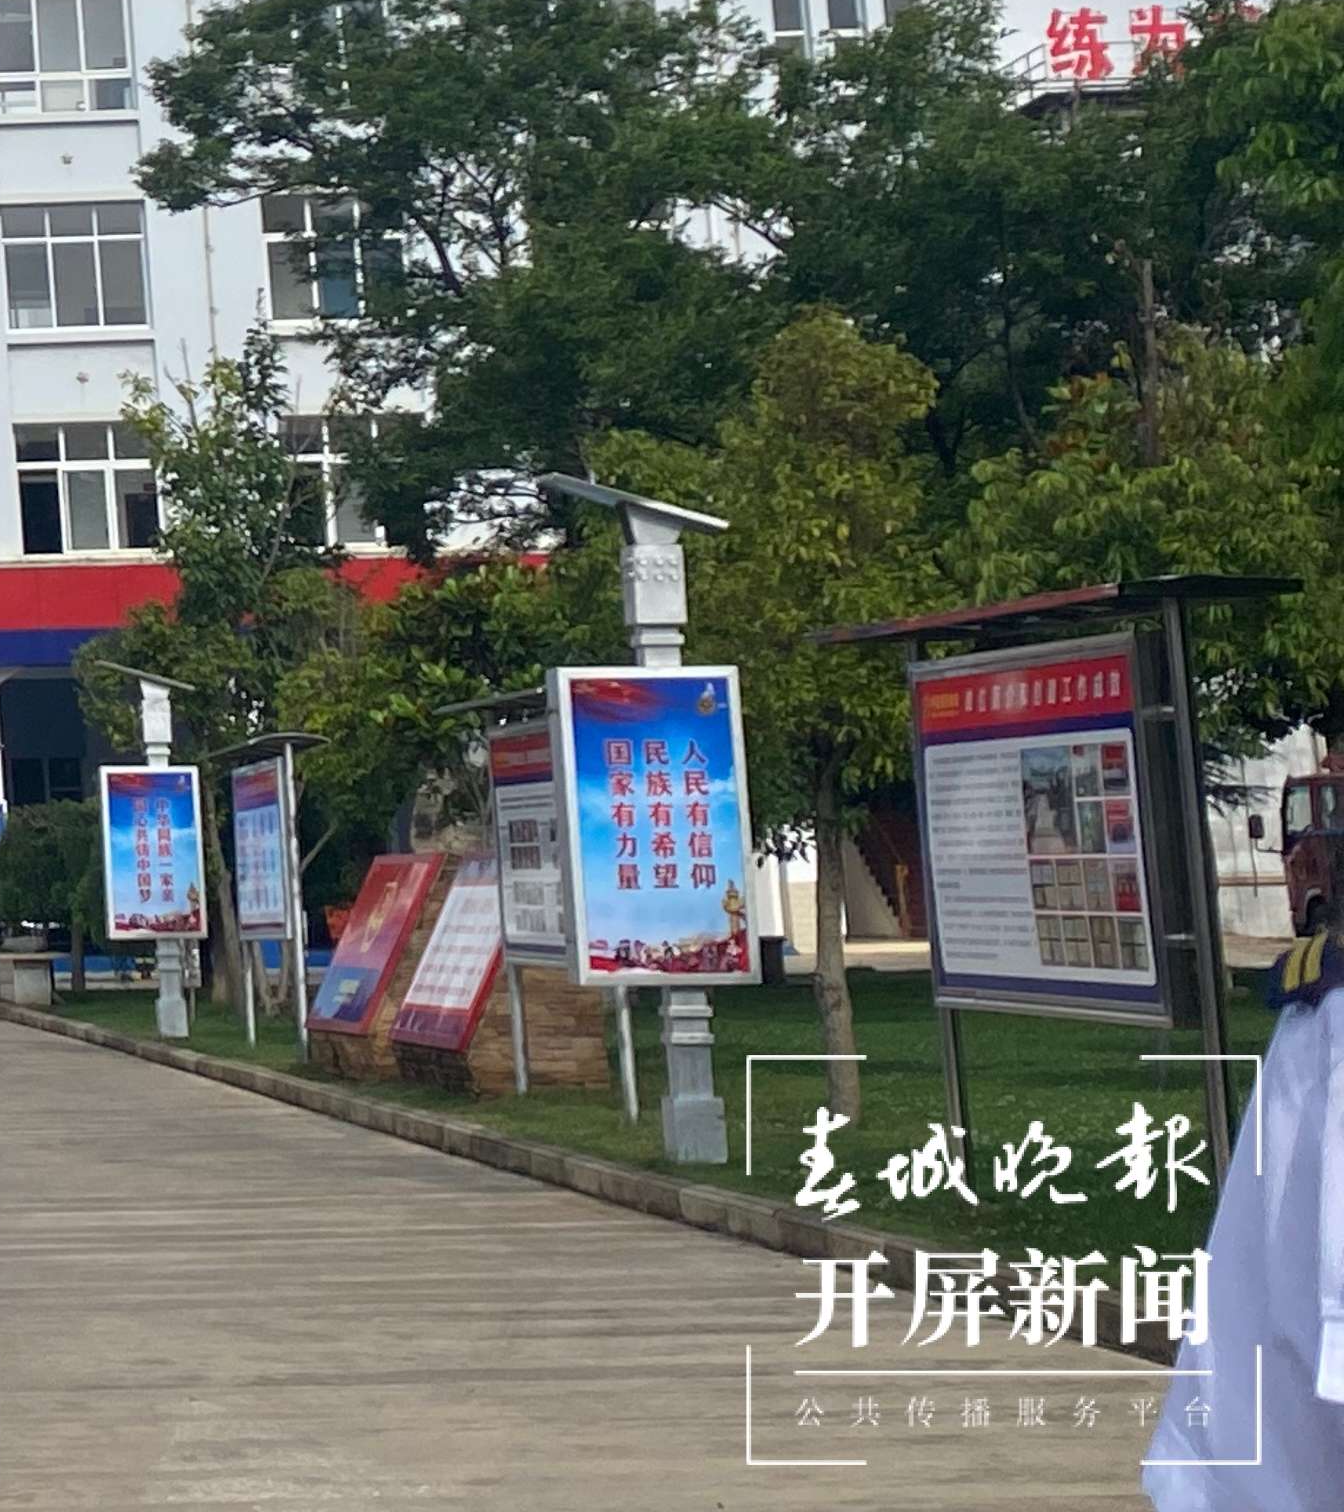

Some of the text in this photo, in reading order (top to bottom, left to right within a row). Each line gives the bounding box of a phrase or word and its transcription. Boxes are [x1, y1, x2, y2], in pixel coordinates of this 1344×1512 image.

[606, 740, 641, 890] 国家有力量
[644, 741, 679, 890] 民族有希望
[682, 740, 716, 889] 人民有信仰
